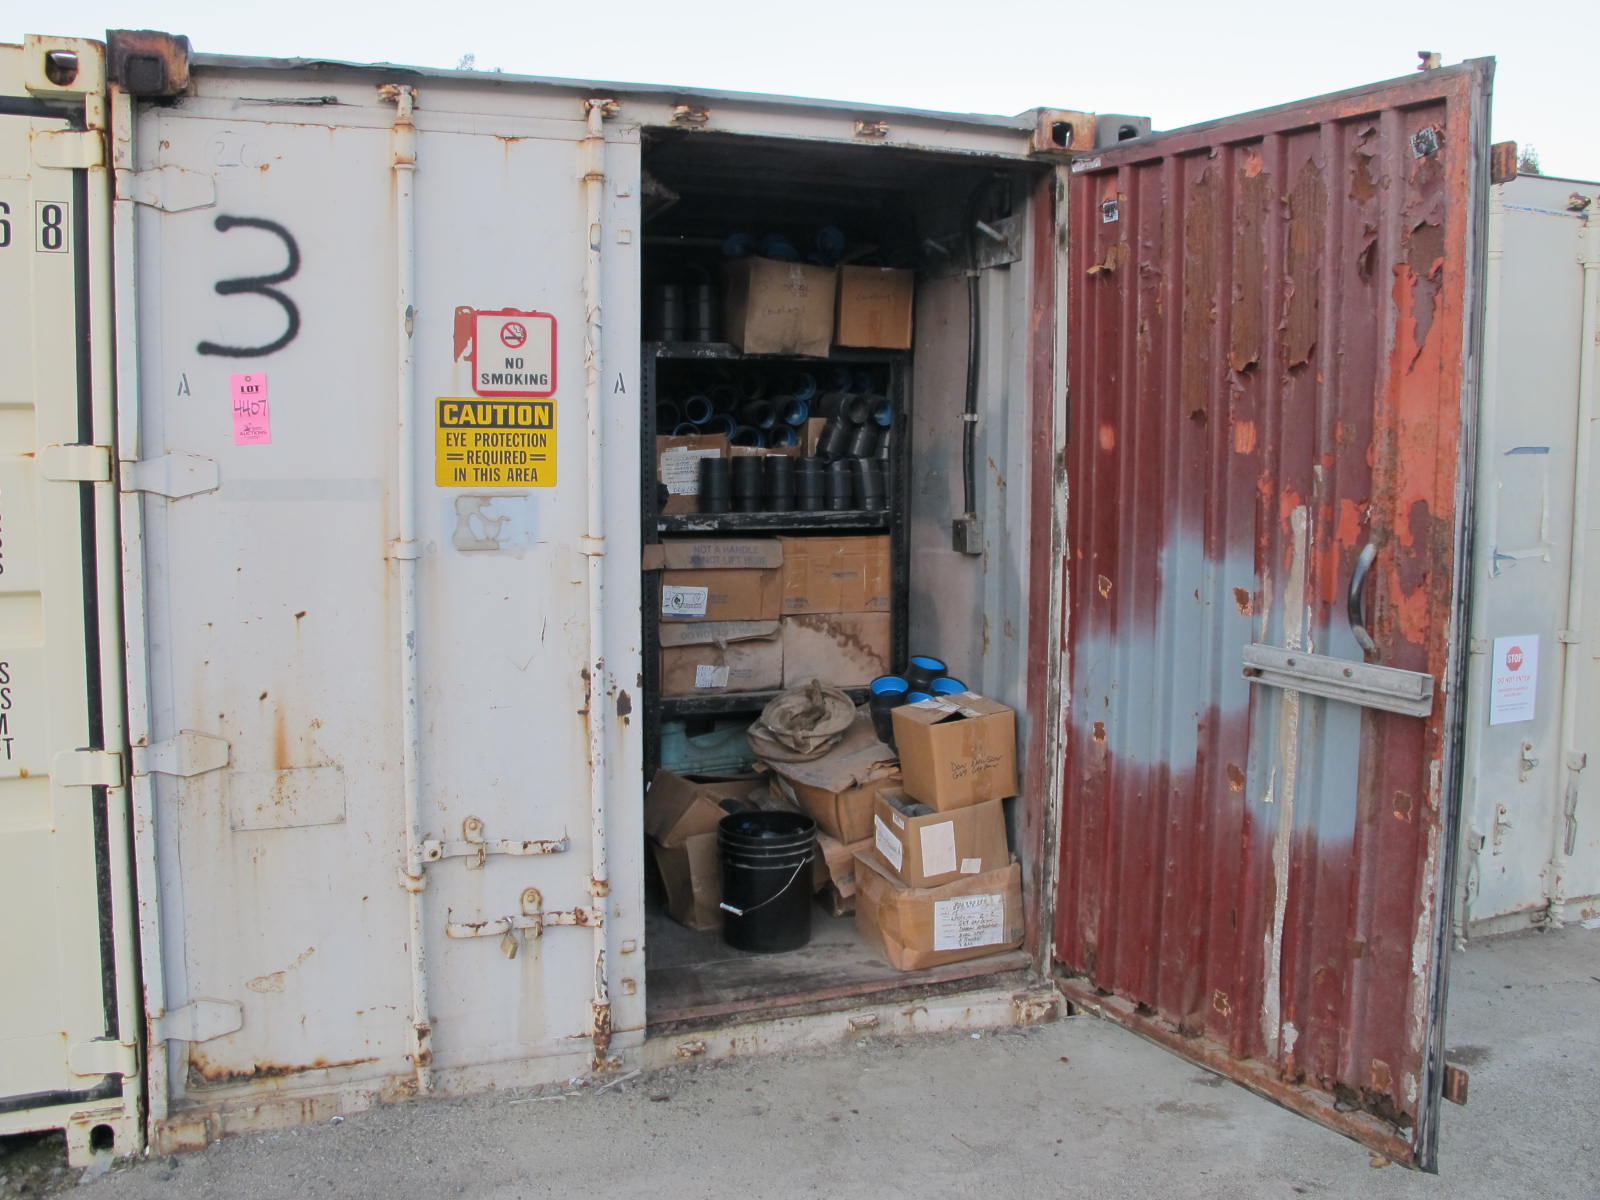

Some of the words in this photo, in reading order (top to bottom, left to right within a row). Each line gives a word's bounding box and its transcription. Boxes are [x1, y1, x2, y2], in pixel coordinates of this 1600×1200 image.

[42, 204, 62, 249] 8
[197, 215, 300, 358] 3
[505, 358, 524, 369] NO
[177, 372, 191, 396] A
[481, 373, 548, 386] SMOKING
[613, 372, 626, 394] A
[240, 385, 259, 393] LOT
[233, 400, 267, 417] 4407
[443, 404, 549, 426] CAUTION
[446, 433, 467, 447] EYE
[474, 433, 547, 448] PROTECTION
[467, 450, 527, 466] REQUIRED
[454, 468, 467, 481] IN
[473, 468, 501, 482] THIS
[507, 468, 538, 482] AREA
[1507, 653, 1523, 664] STOP
